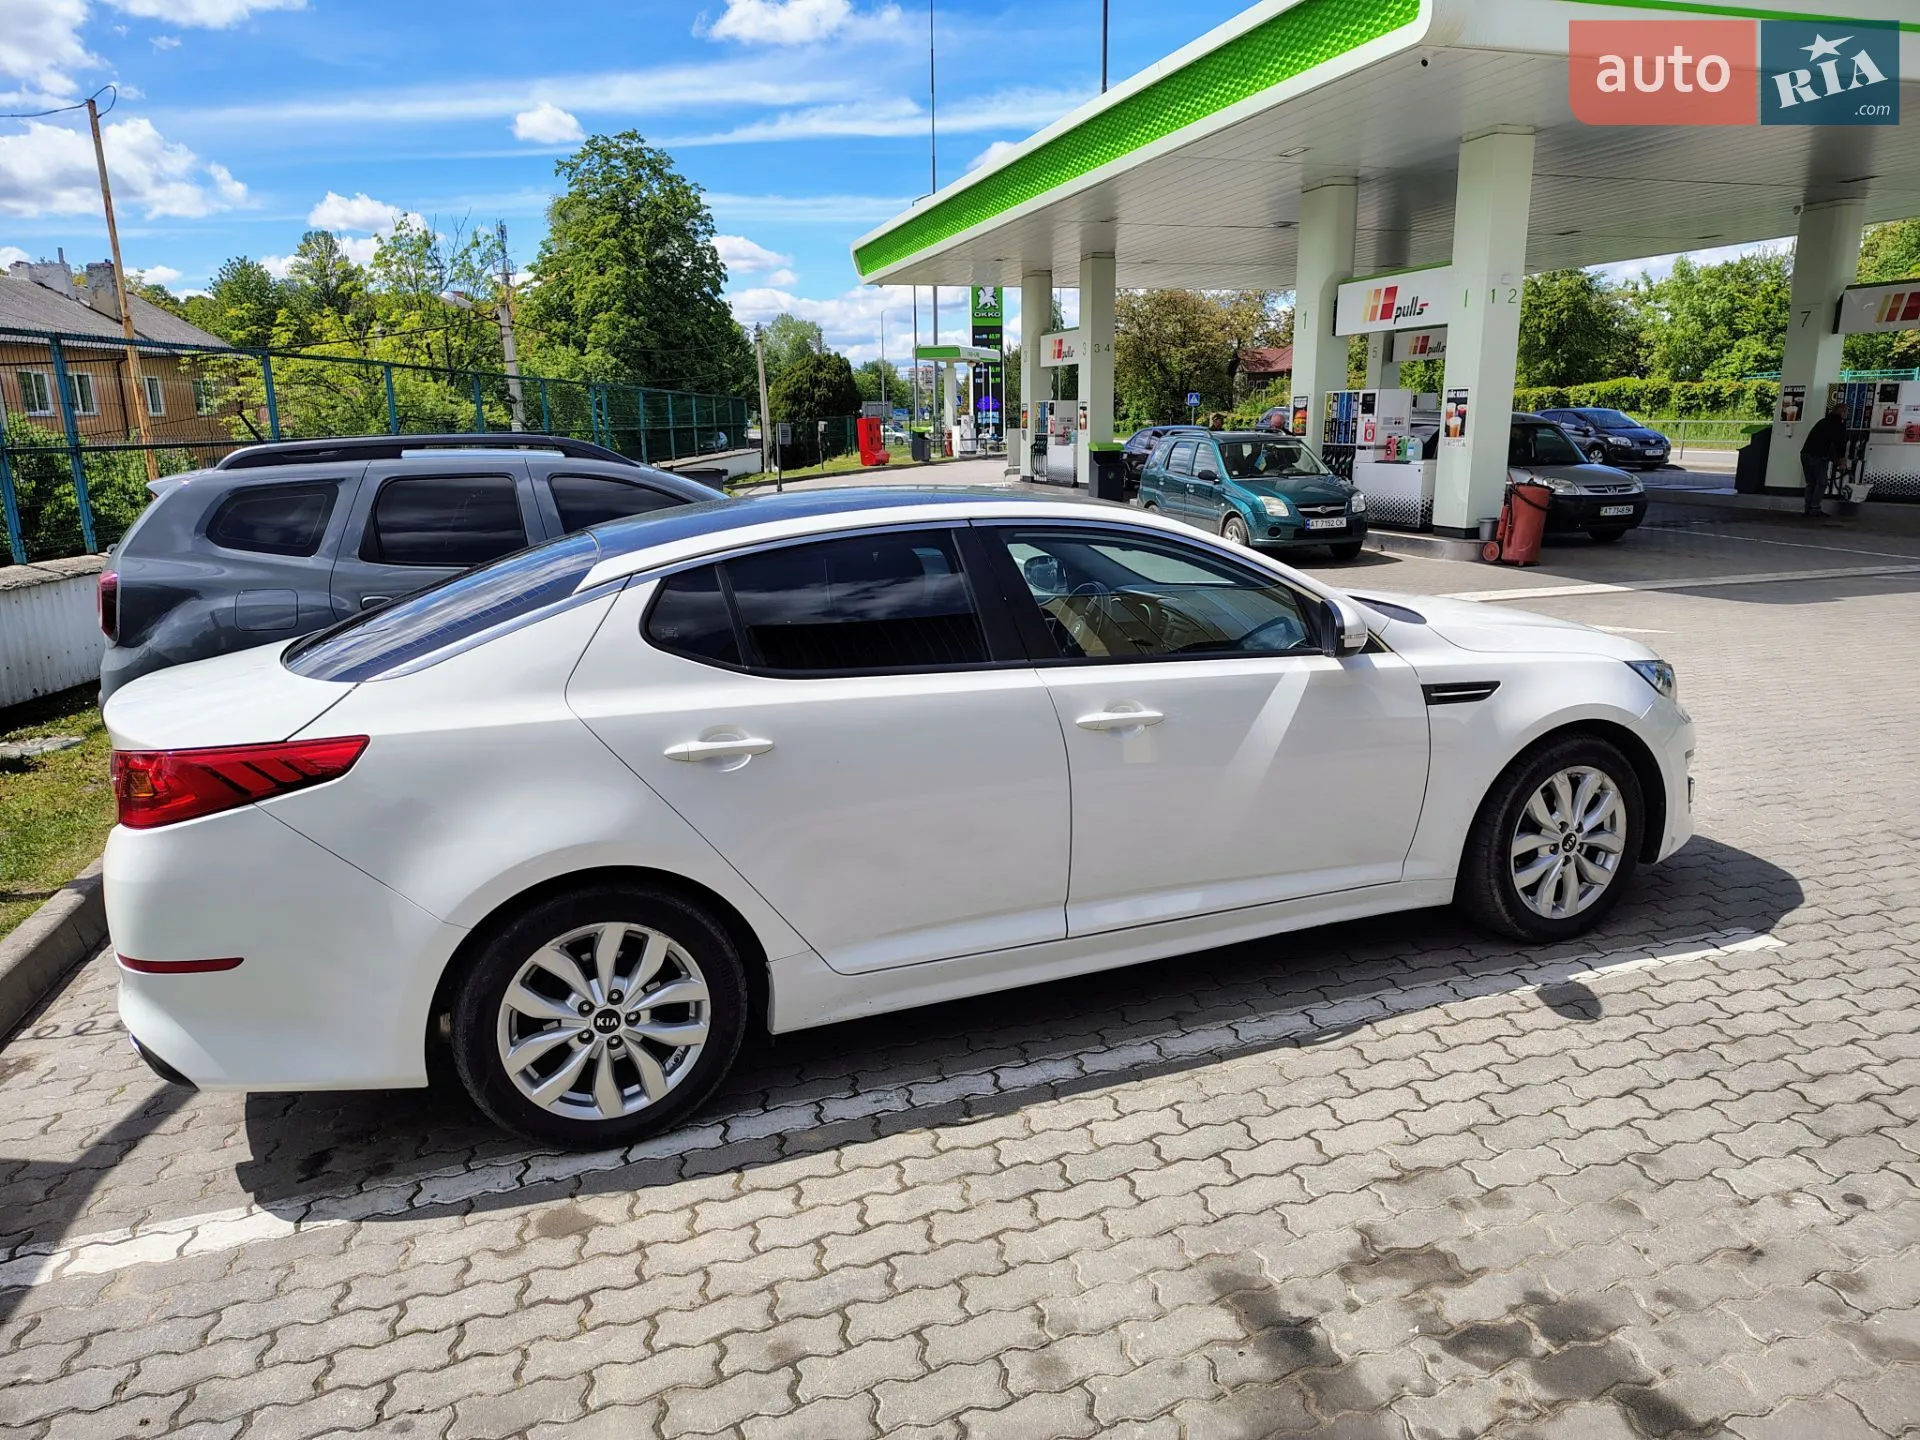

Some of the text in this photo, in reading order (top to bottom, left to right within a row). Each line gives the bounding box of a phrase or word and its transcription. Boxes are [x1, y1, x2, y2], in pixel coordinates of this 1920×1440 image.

[1508, 288, 1517, 304] 2
[1393, 296, 1429, 325] pulls
[1302, 311, 1307, 329] 1
[1801, 311, 1811, 328] 7
[1094, 343, 1110, 353] 3 4
[1426, 341, 1447, 357] pulls
[1320, 519, 1335, 527] 7152
[597, 1018, 618, 1026] KIA
